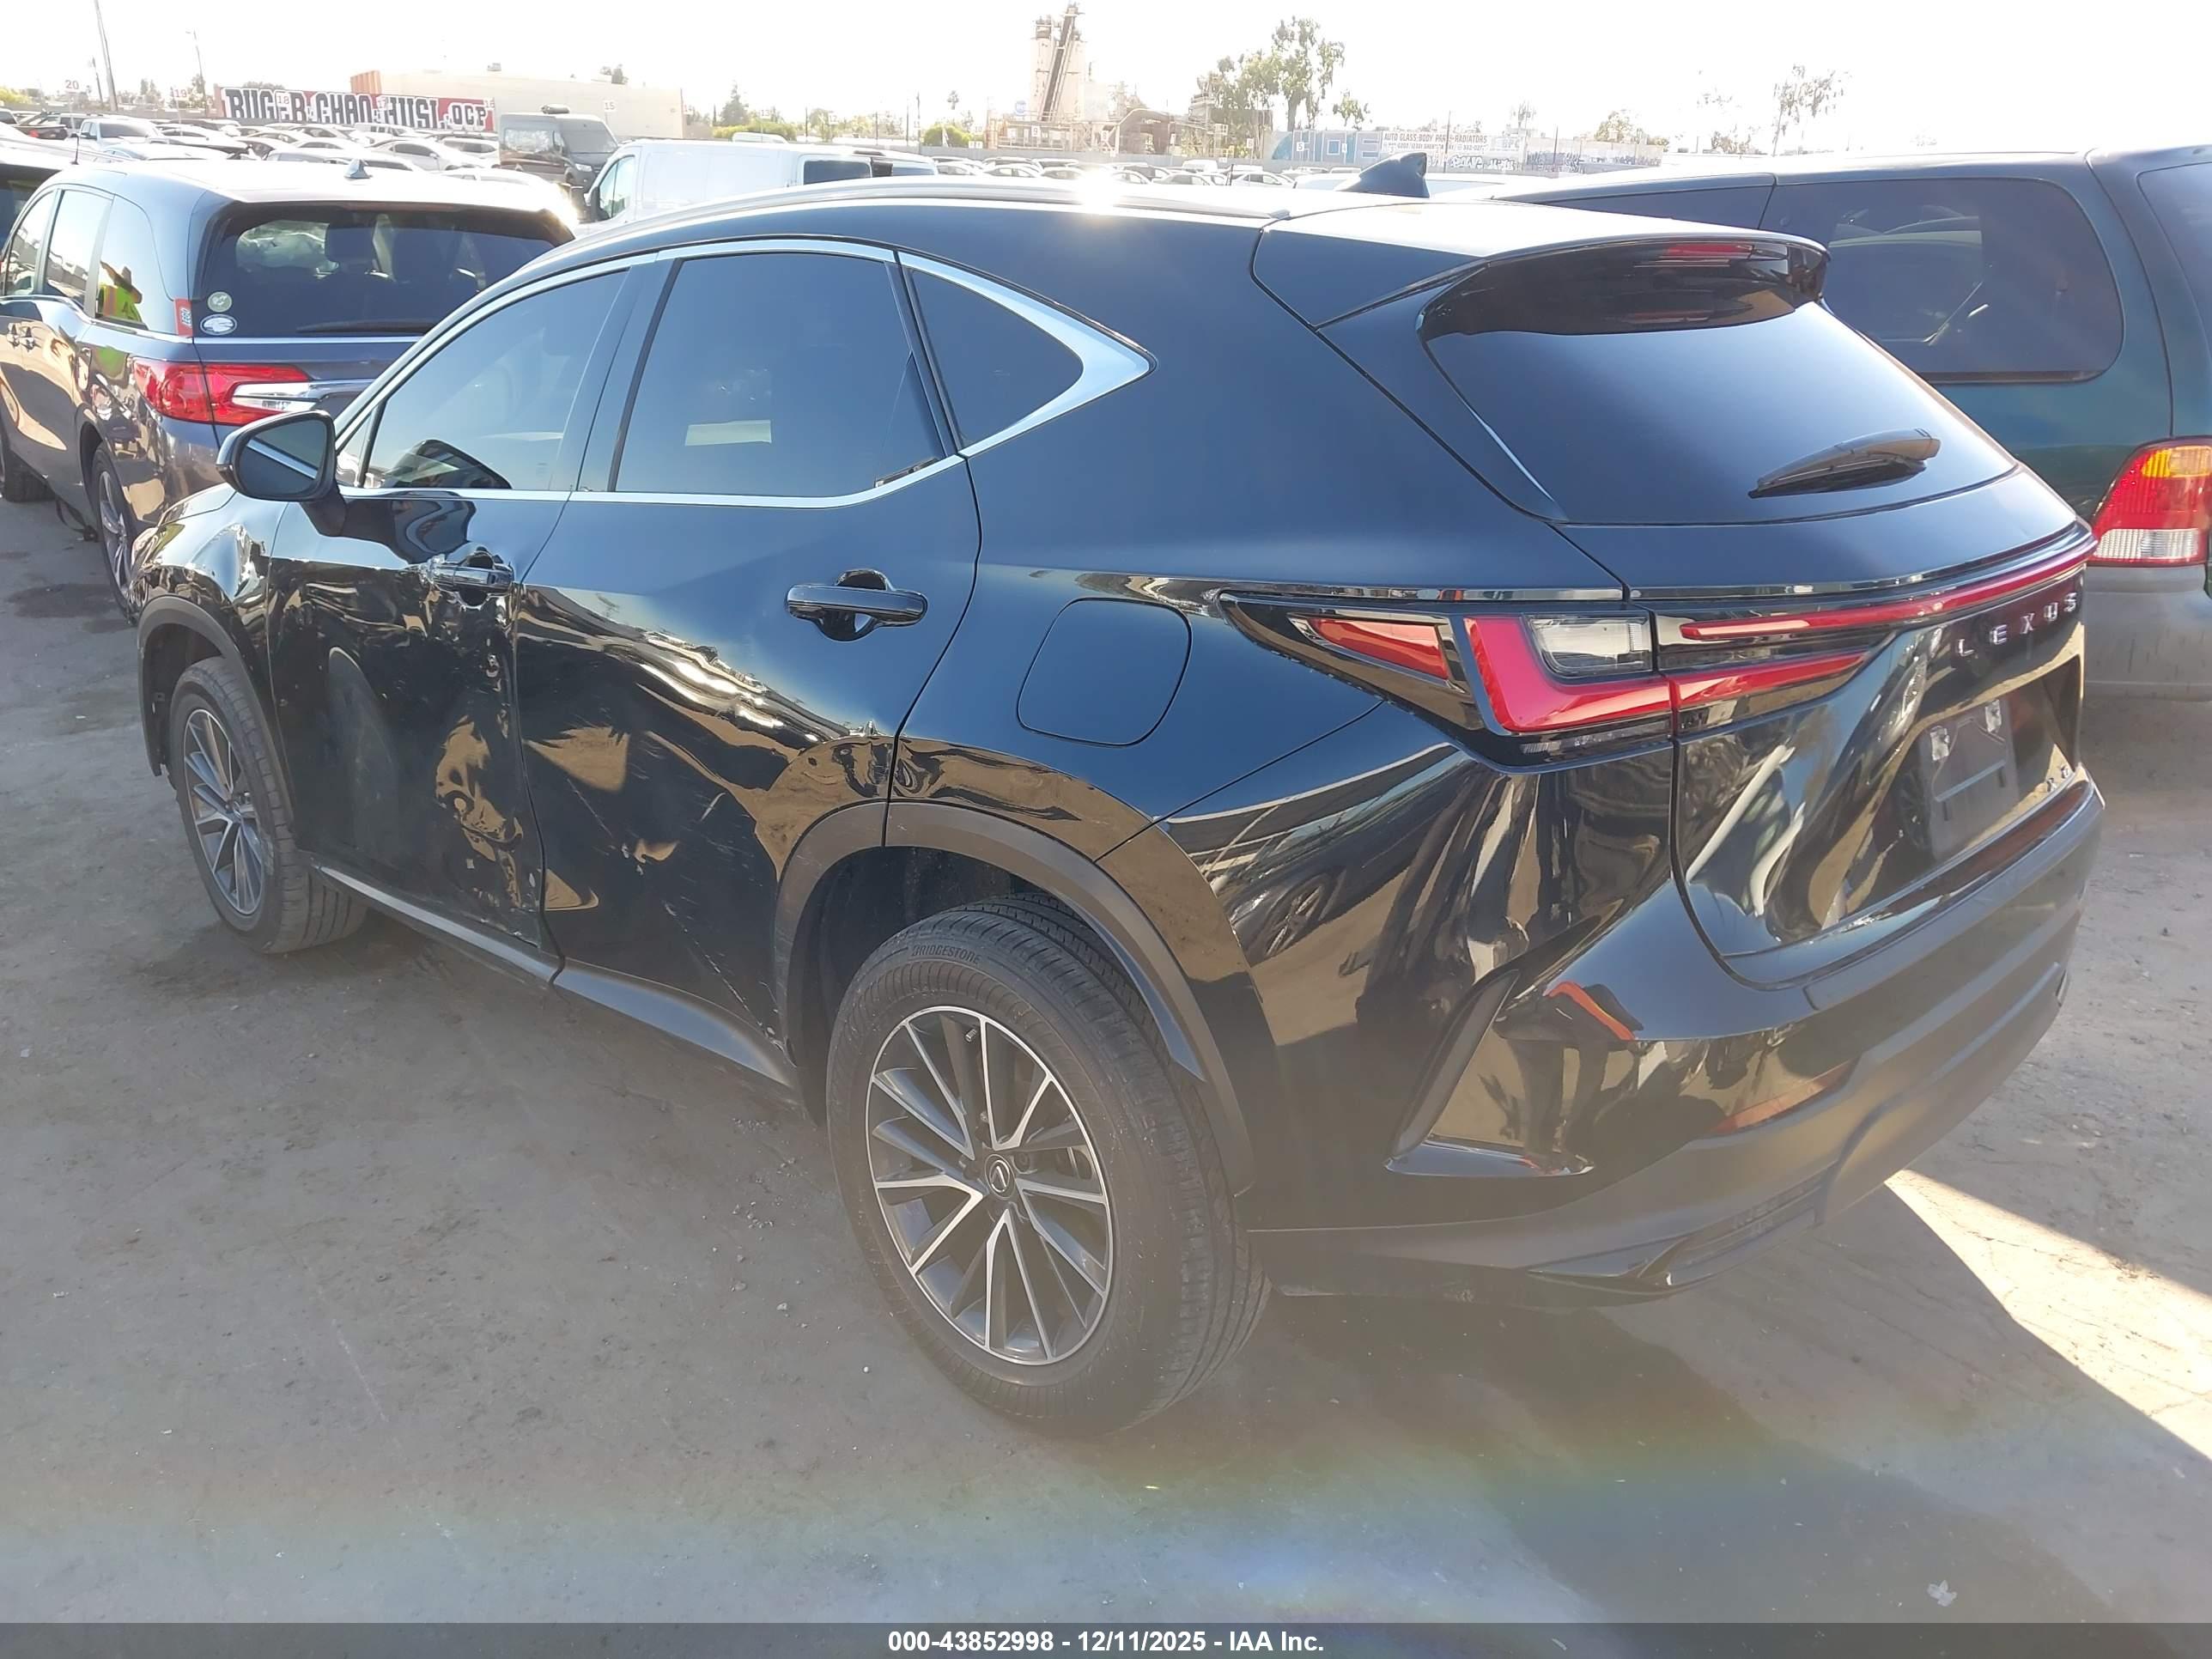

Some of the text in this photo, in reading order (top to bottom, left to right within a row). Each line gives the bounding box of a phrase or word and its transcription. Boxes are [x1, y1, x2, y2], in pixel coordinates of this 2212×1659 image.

[605, 101, 615, 110] 15
[1958, 592, 2077, 657] LEXUS
[910, 945, 982, 964] BRIDGESTONE
